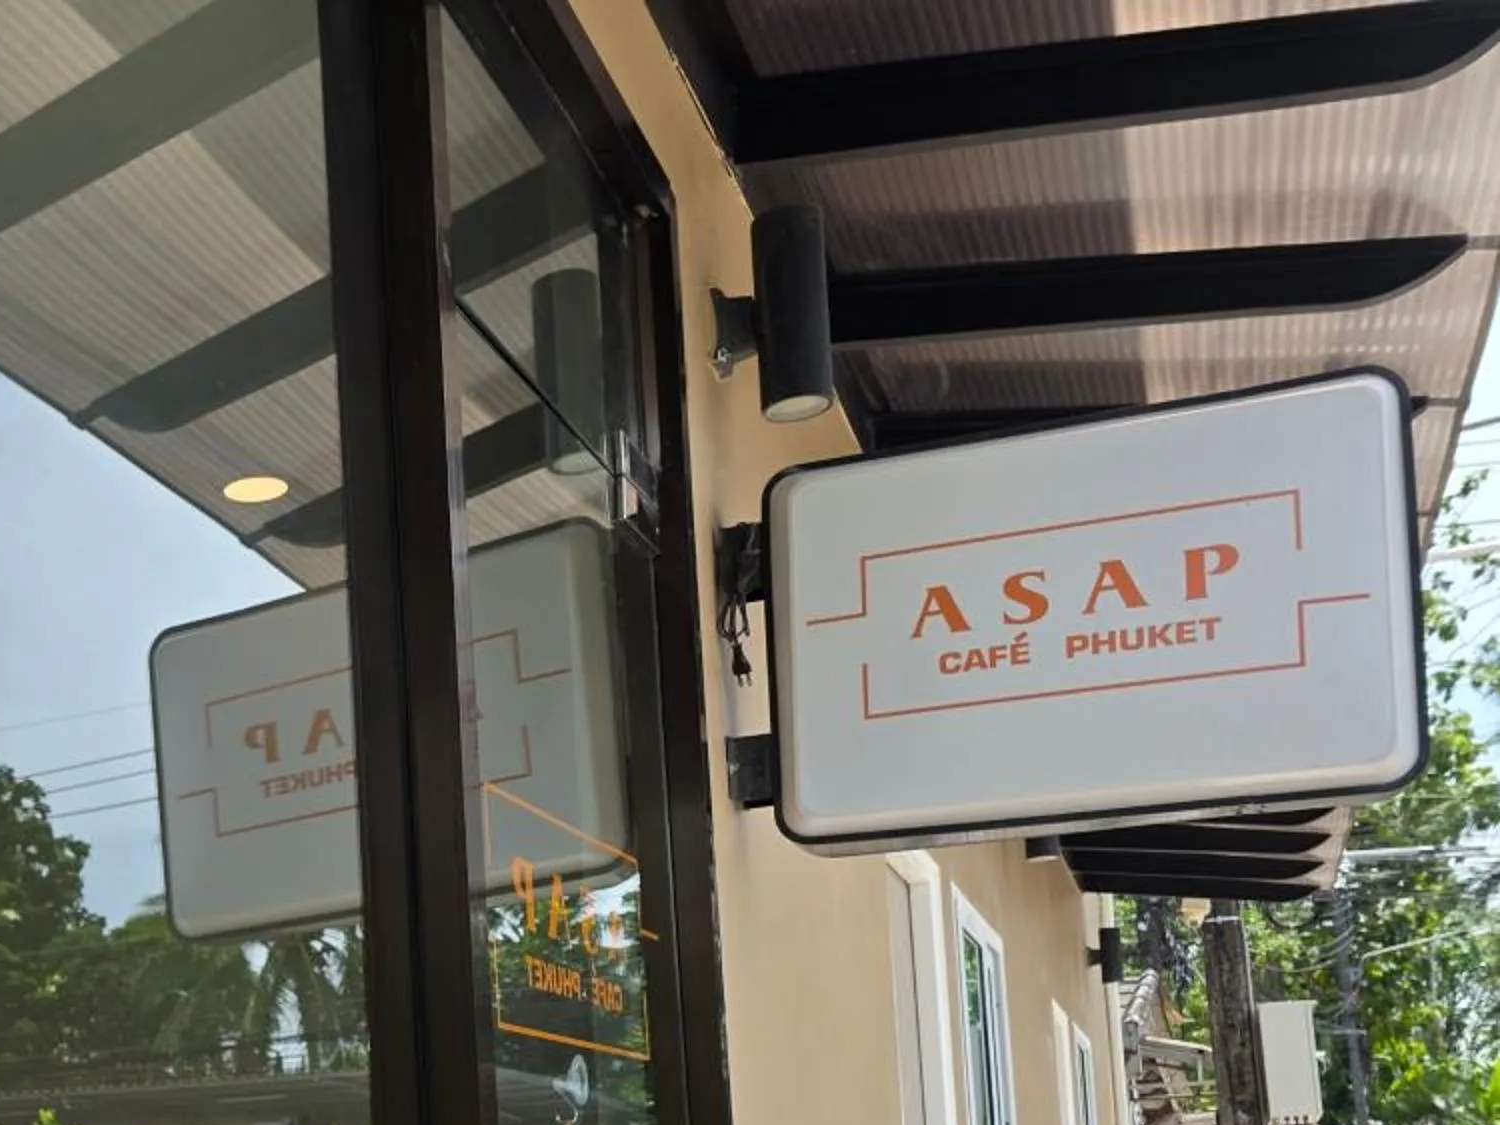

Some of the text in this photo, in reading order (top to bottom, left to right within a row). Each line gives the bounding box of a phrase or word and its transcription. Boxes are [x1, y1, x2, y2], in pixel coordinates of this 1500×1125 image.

[910, 543, 1240, 639] ASAP
[938, 616, 1222, 675] CAFÉ PHUKET
